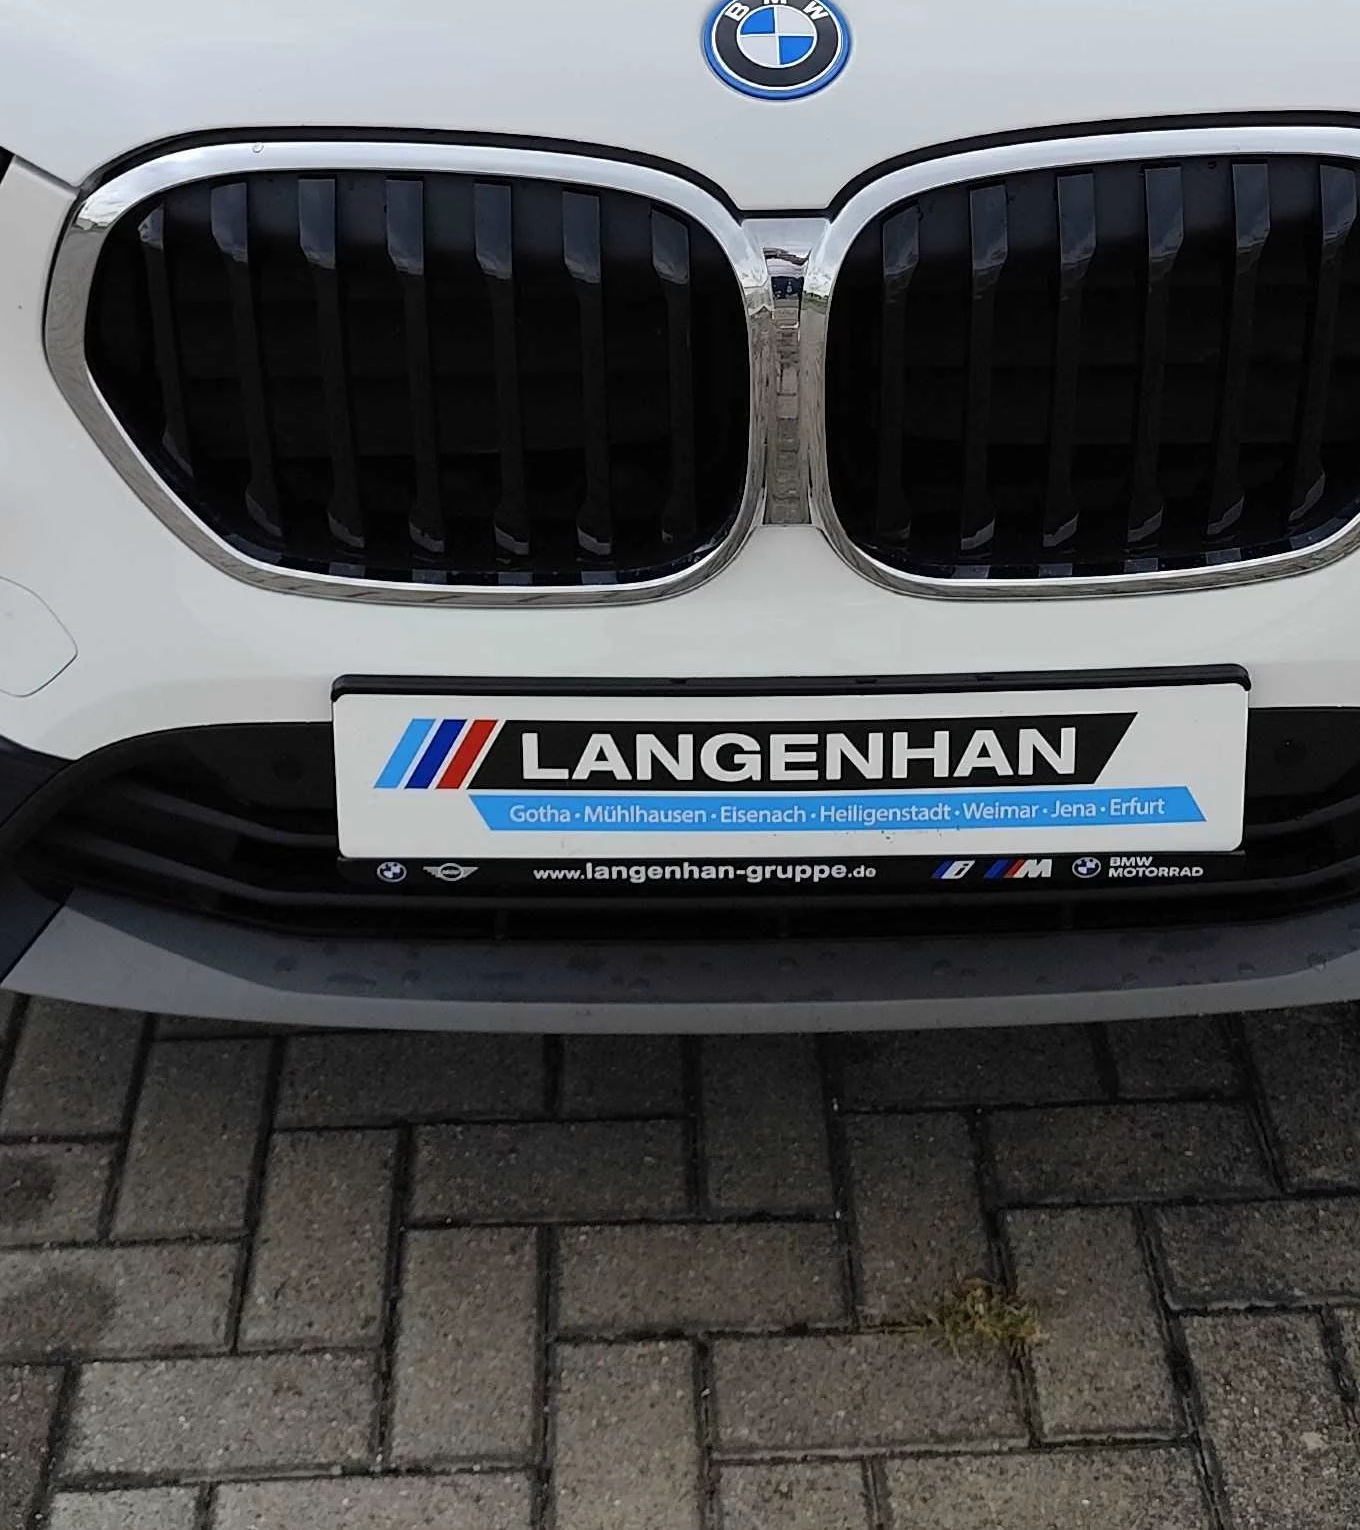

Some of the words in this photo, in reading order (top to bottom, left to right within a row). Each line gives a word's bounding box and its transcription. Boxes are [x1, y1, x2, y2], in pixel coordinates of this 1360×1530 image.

[521, 727, 1077, 782] LANGENHAN
[509, 804, 571, 823] Gotha
[584, 805, 707, 823] Mühlhausen
[720, 805, 807, 823] Eisenach
[820, 802, 952, 826] Heiligenstadt
[962, 801, 1040, 820] Weimar
[1050, 800, 1097, 818] Jena
[1110, 797, 1166, 815] Erfurt
[533, 861, 877, 884] www.langenhan-gruppe.de
[1108, 866, 1204, 878] MOTORRAD
[1109, 856, 1153, 867] BMW
